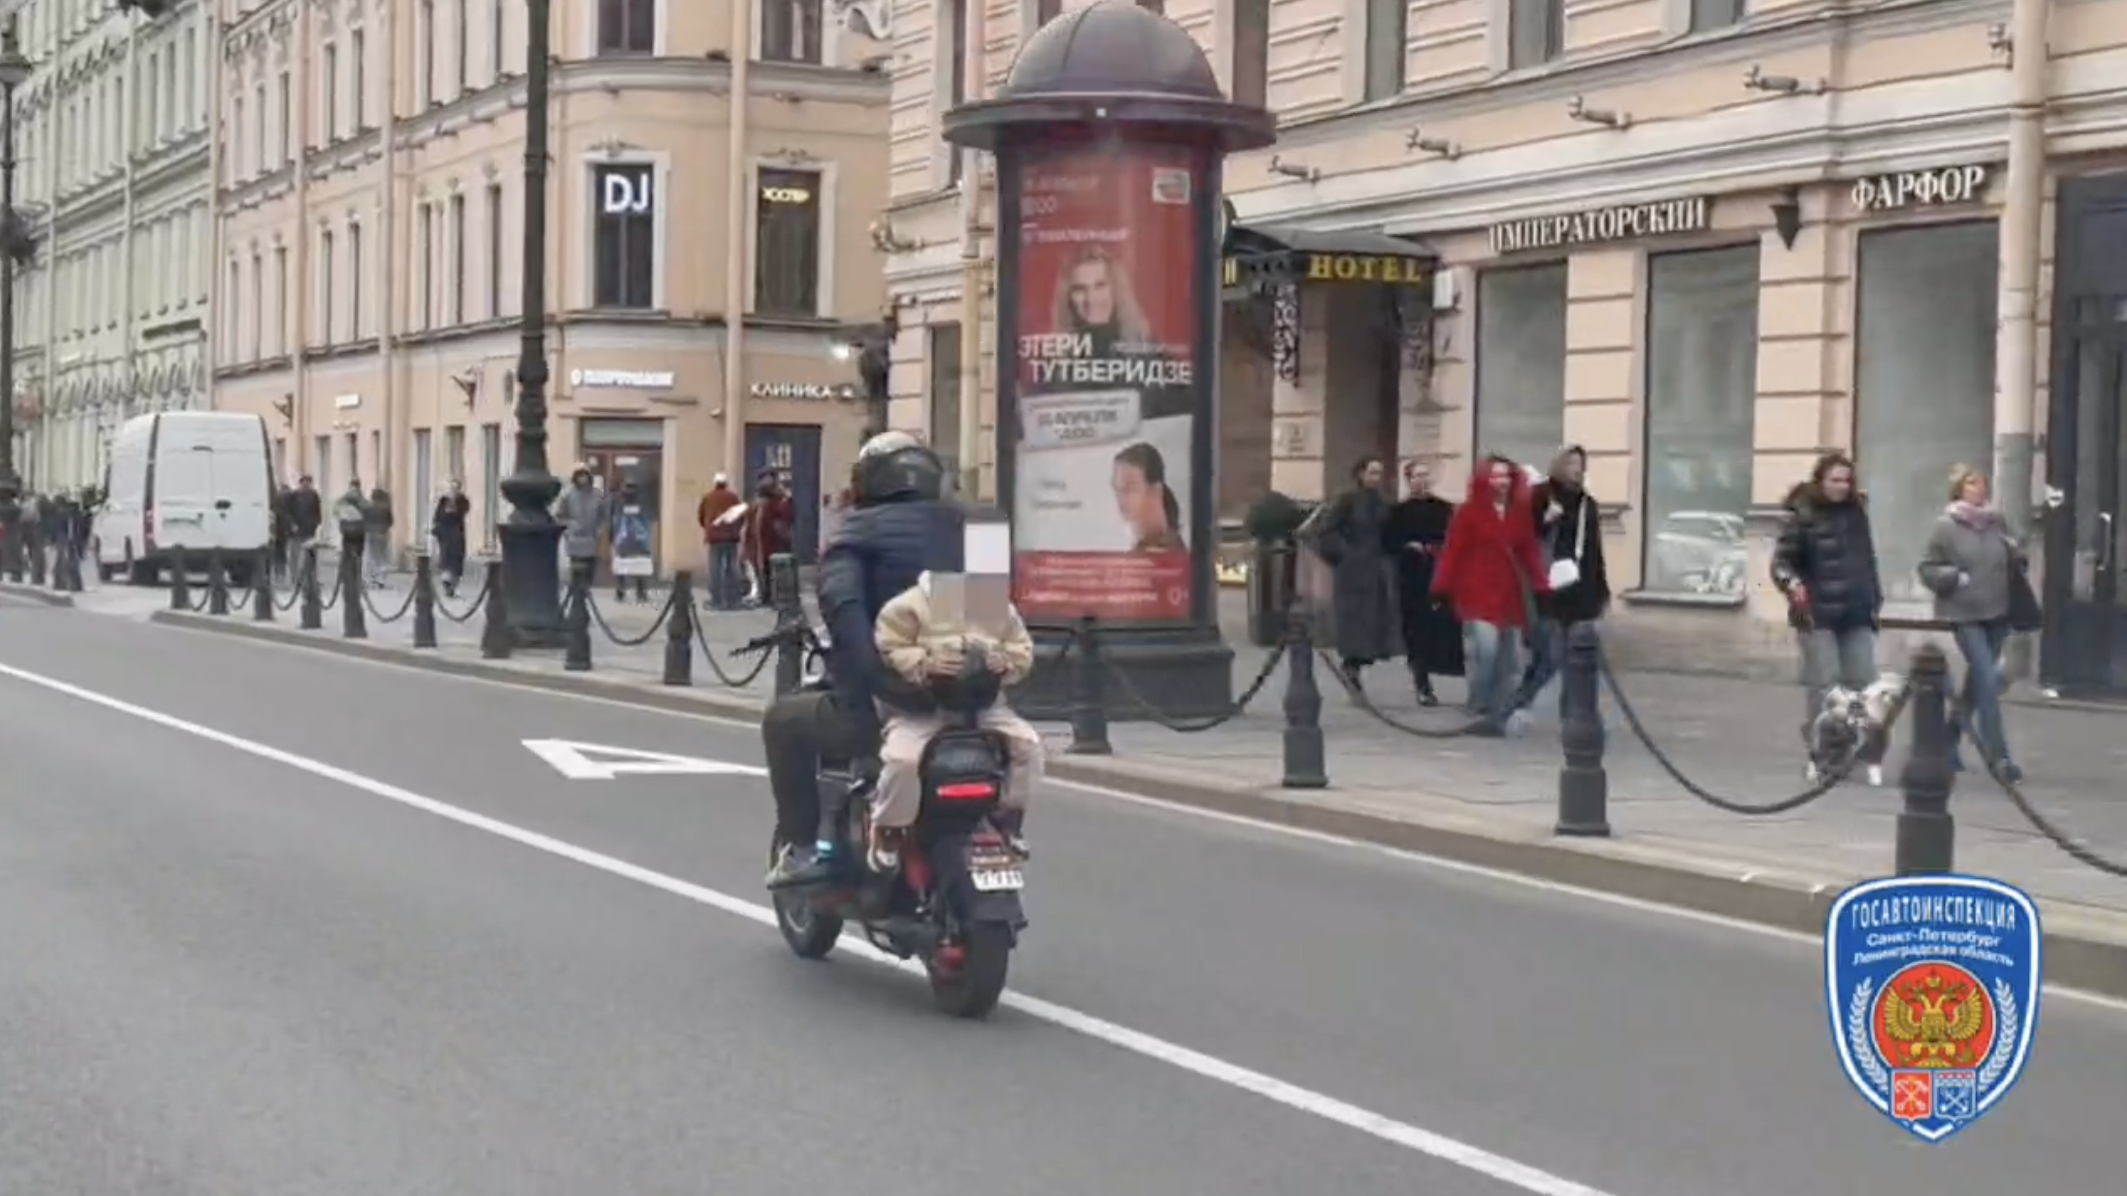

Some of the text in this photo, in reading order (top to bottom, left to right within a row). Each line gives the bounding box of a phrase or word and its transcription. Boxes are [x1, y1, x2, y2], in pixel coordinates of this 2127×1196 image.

[604, 173, 649, 213] DJ
[1851, 166, 1985, 210] ФАРФОР
[1309, 254, 1421, 283] HOTEL
[1018, 333, 1093, 357] ЭТЕРИ
[1029, 359, 1193, 386] ТУТБЕРИДЗЕ
[751, 383, 832, 397] КЛИНИКА
